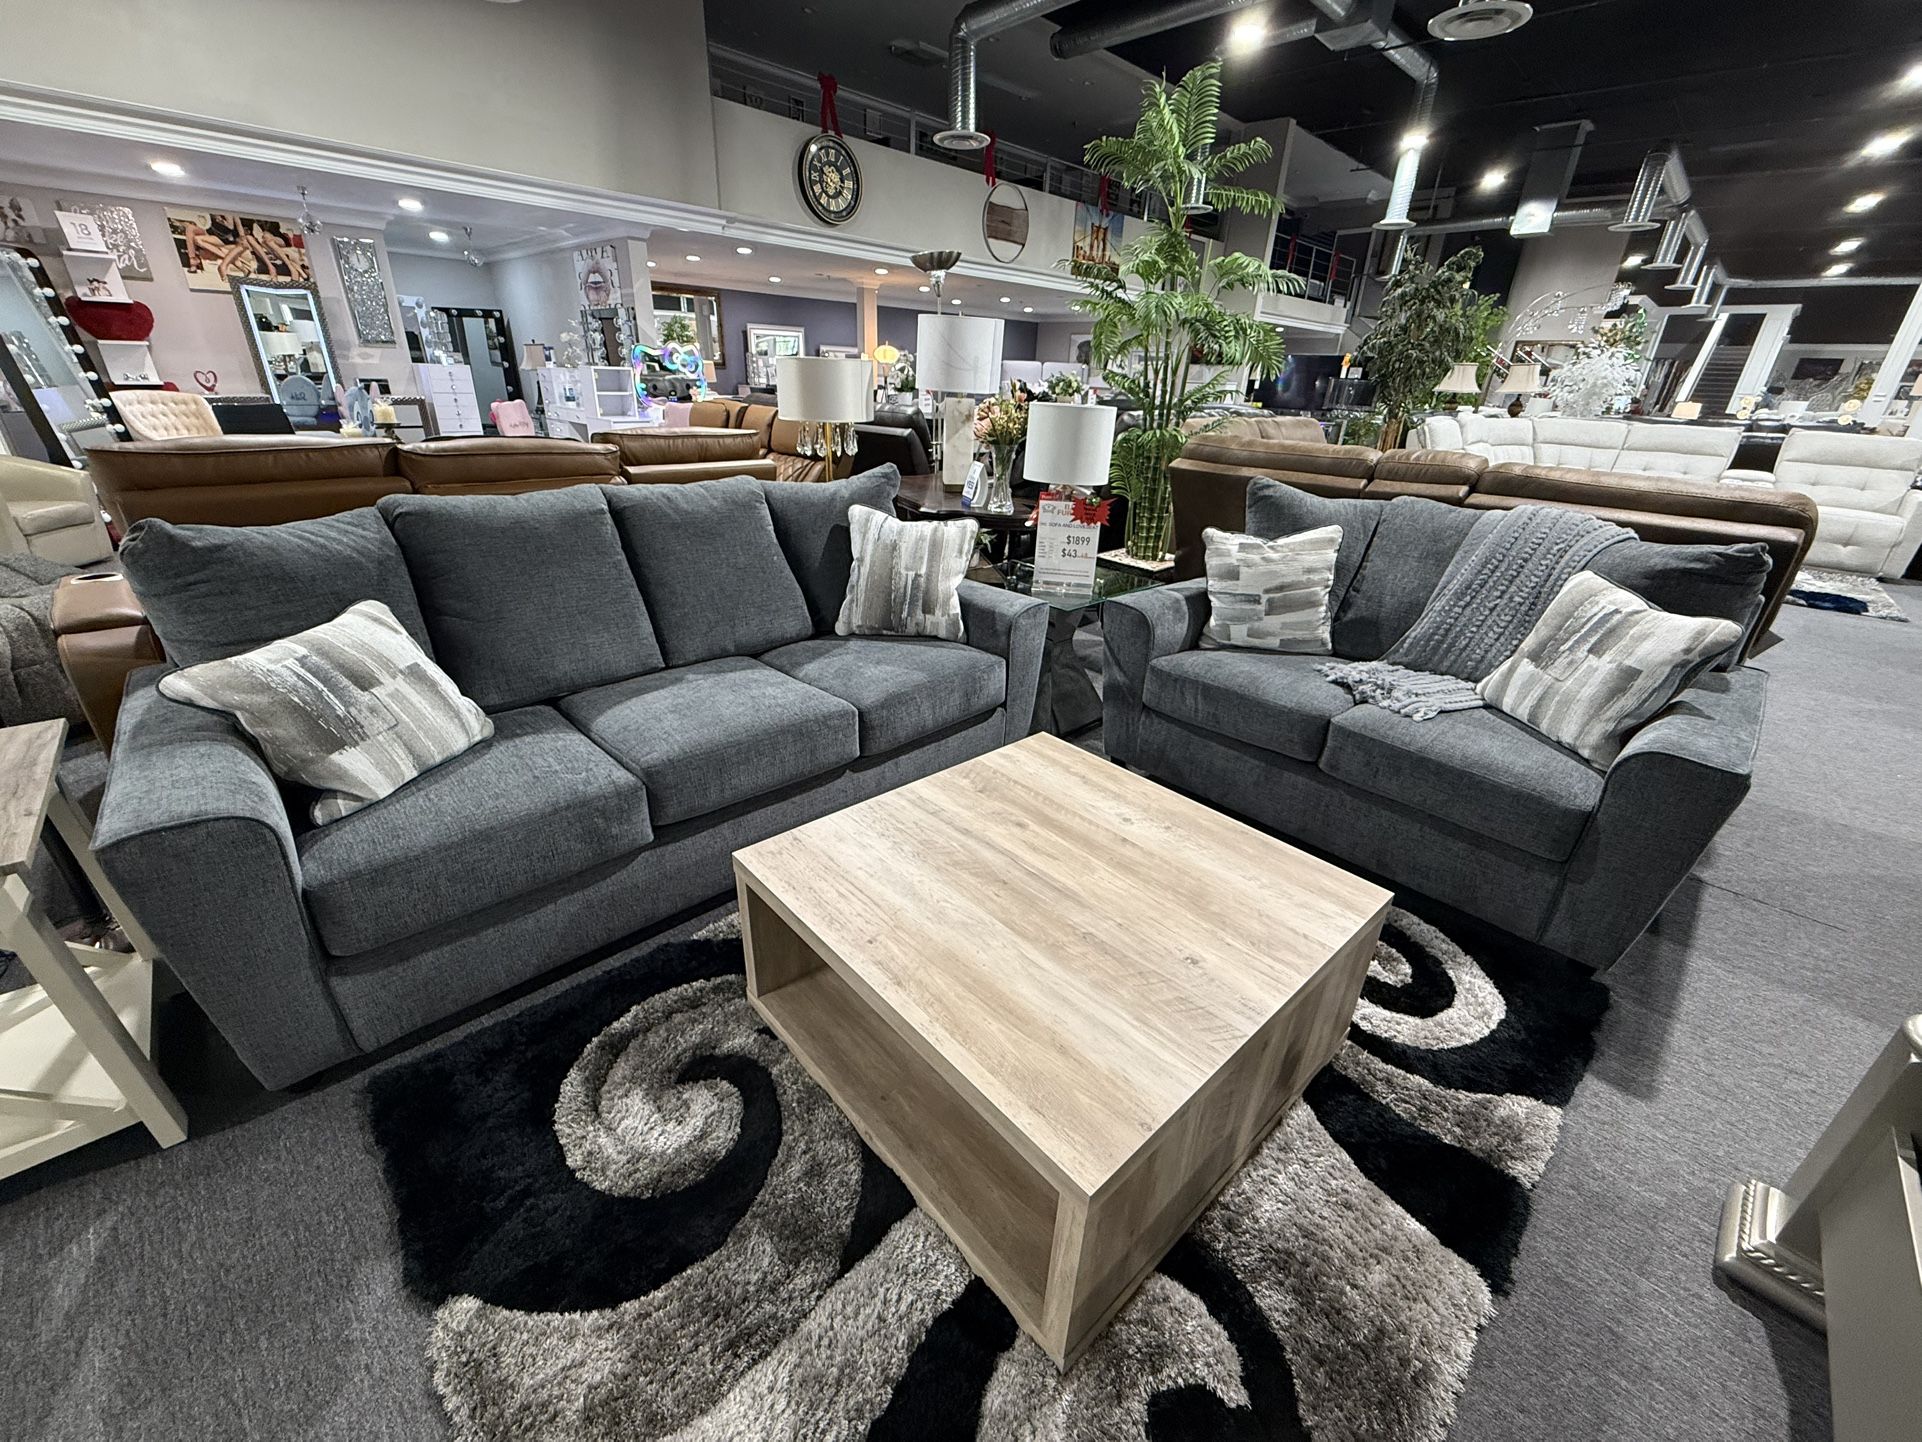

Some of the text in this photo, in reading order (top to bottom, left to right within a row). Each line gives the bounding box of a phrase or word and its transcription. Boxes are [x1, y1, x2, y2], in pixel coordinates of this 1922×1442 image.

[70, 222, 92, 236] 18
[1066, 535, 1091, 546] $1899
[1061, 547, 1077, 558] $43
